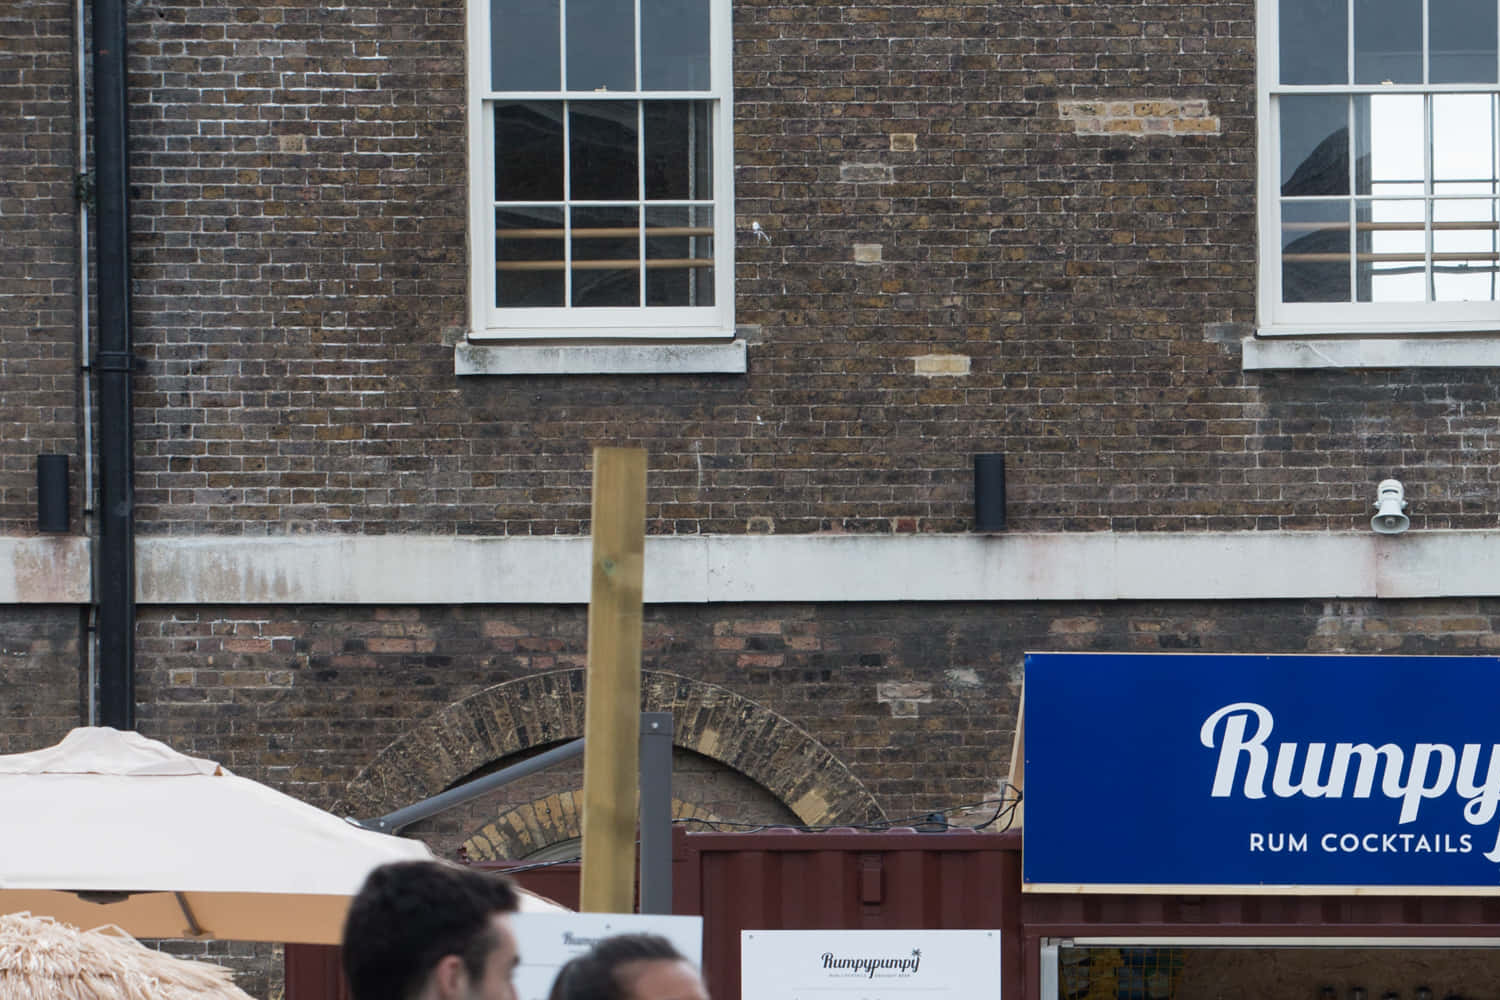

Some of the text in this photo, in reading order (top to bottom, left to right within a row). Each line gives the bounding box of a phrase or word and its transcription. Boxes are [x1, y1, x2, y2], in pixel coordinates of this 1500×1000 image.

[1250, 833, 1308, 853] RUM
[1321, 833, 1473, 854] COCKTAILS
[821, 948, 922, 979] Rumpypumpy
